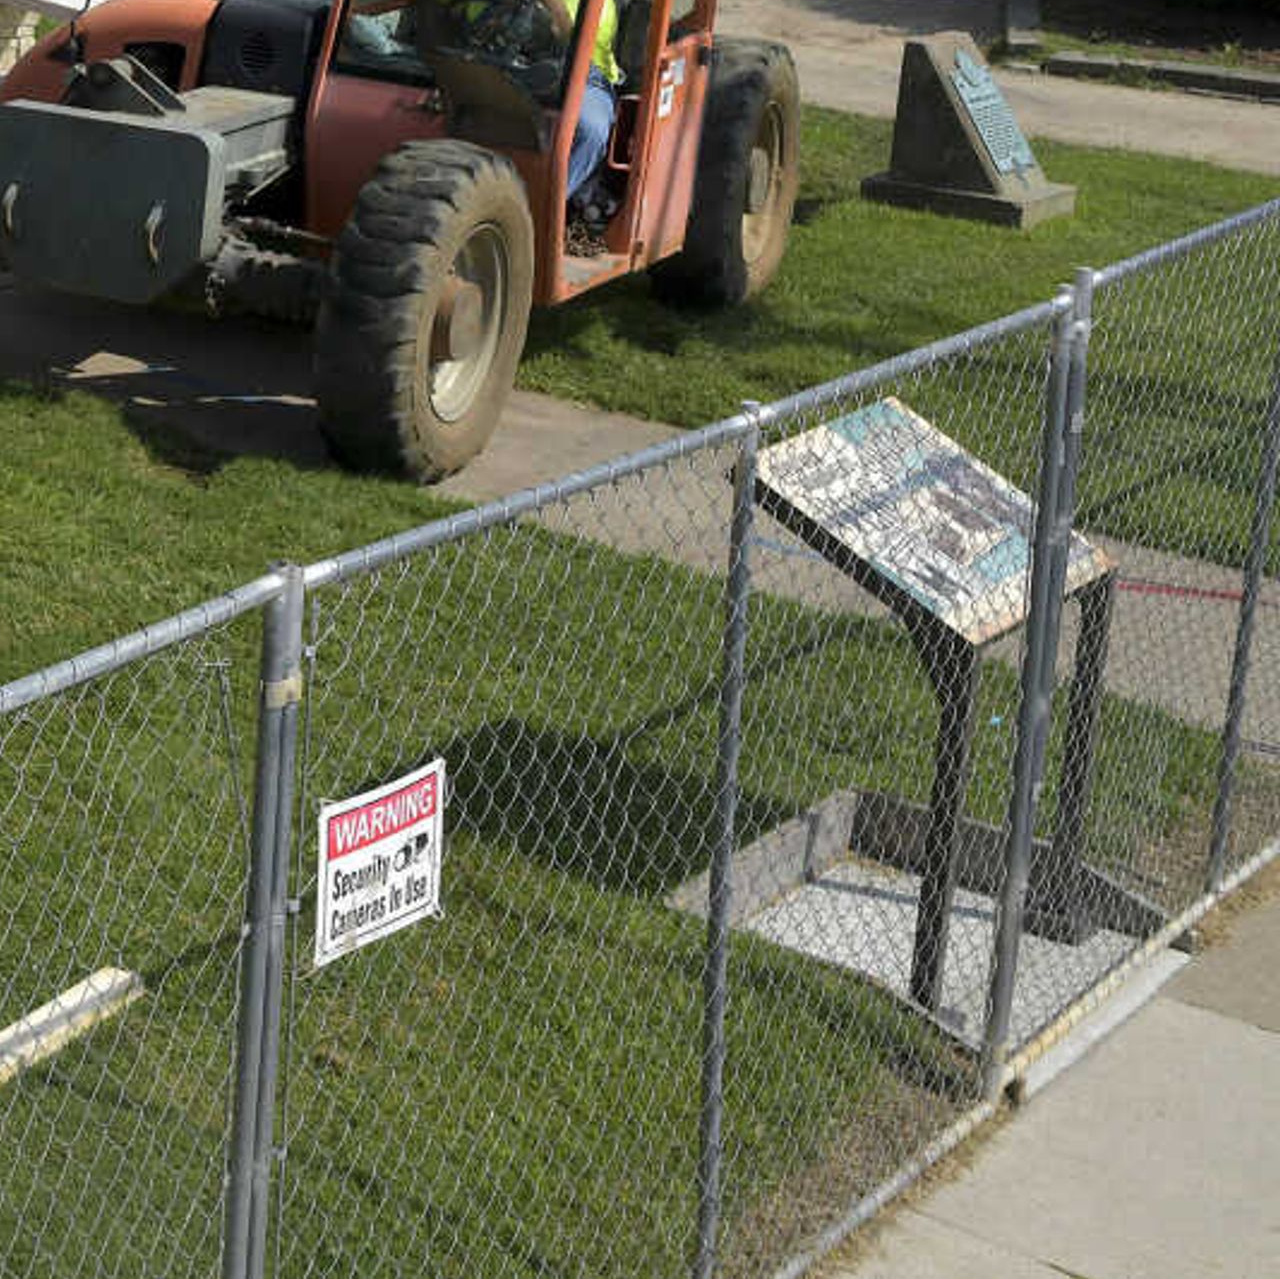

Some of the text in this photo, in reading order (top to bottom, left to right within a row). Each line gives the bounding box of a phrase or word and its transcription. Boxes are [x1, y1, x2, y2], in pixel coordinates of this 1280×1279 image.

[334, 782, 433, 853] WARNING
[330, 874, 428, 941] Cameras In Use
[332, 854, 391, 902] Security
